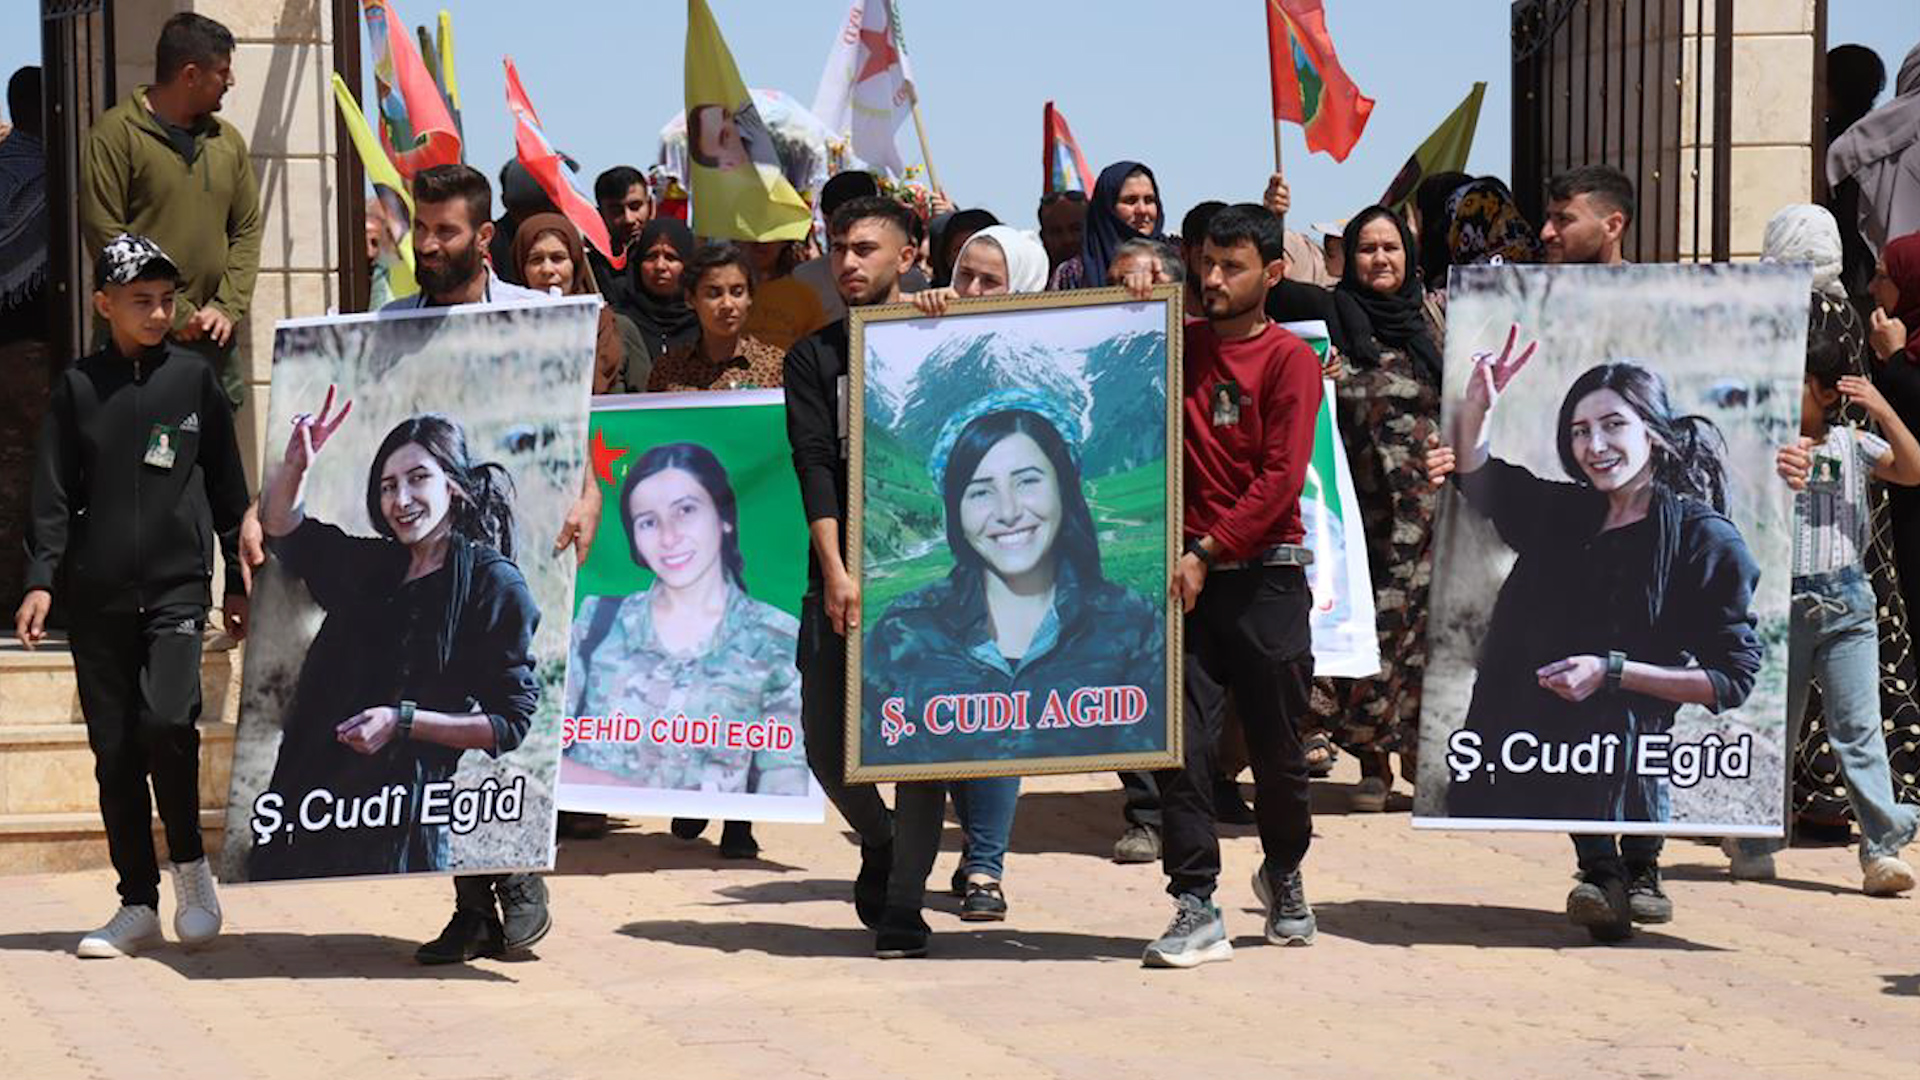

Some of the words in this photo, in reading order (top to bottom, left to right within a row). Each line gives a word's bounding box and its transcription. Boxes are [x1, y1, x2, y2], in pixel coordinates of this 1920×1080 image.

[651, 713, 720, 746] CÛDÎ
[727, 717, 794, 750] EGÎD
[882, 697, 916, 745] Ş.
[924, 690, 1031, 735] CUDI
[1037, 685, 1148, 730] AGID
[1636, 733, 1751, 787] Egîd
[420, 776, 525, 834] Egîd
